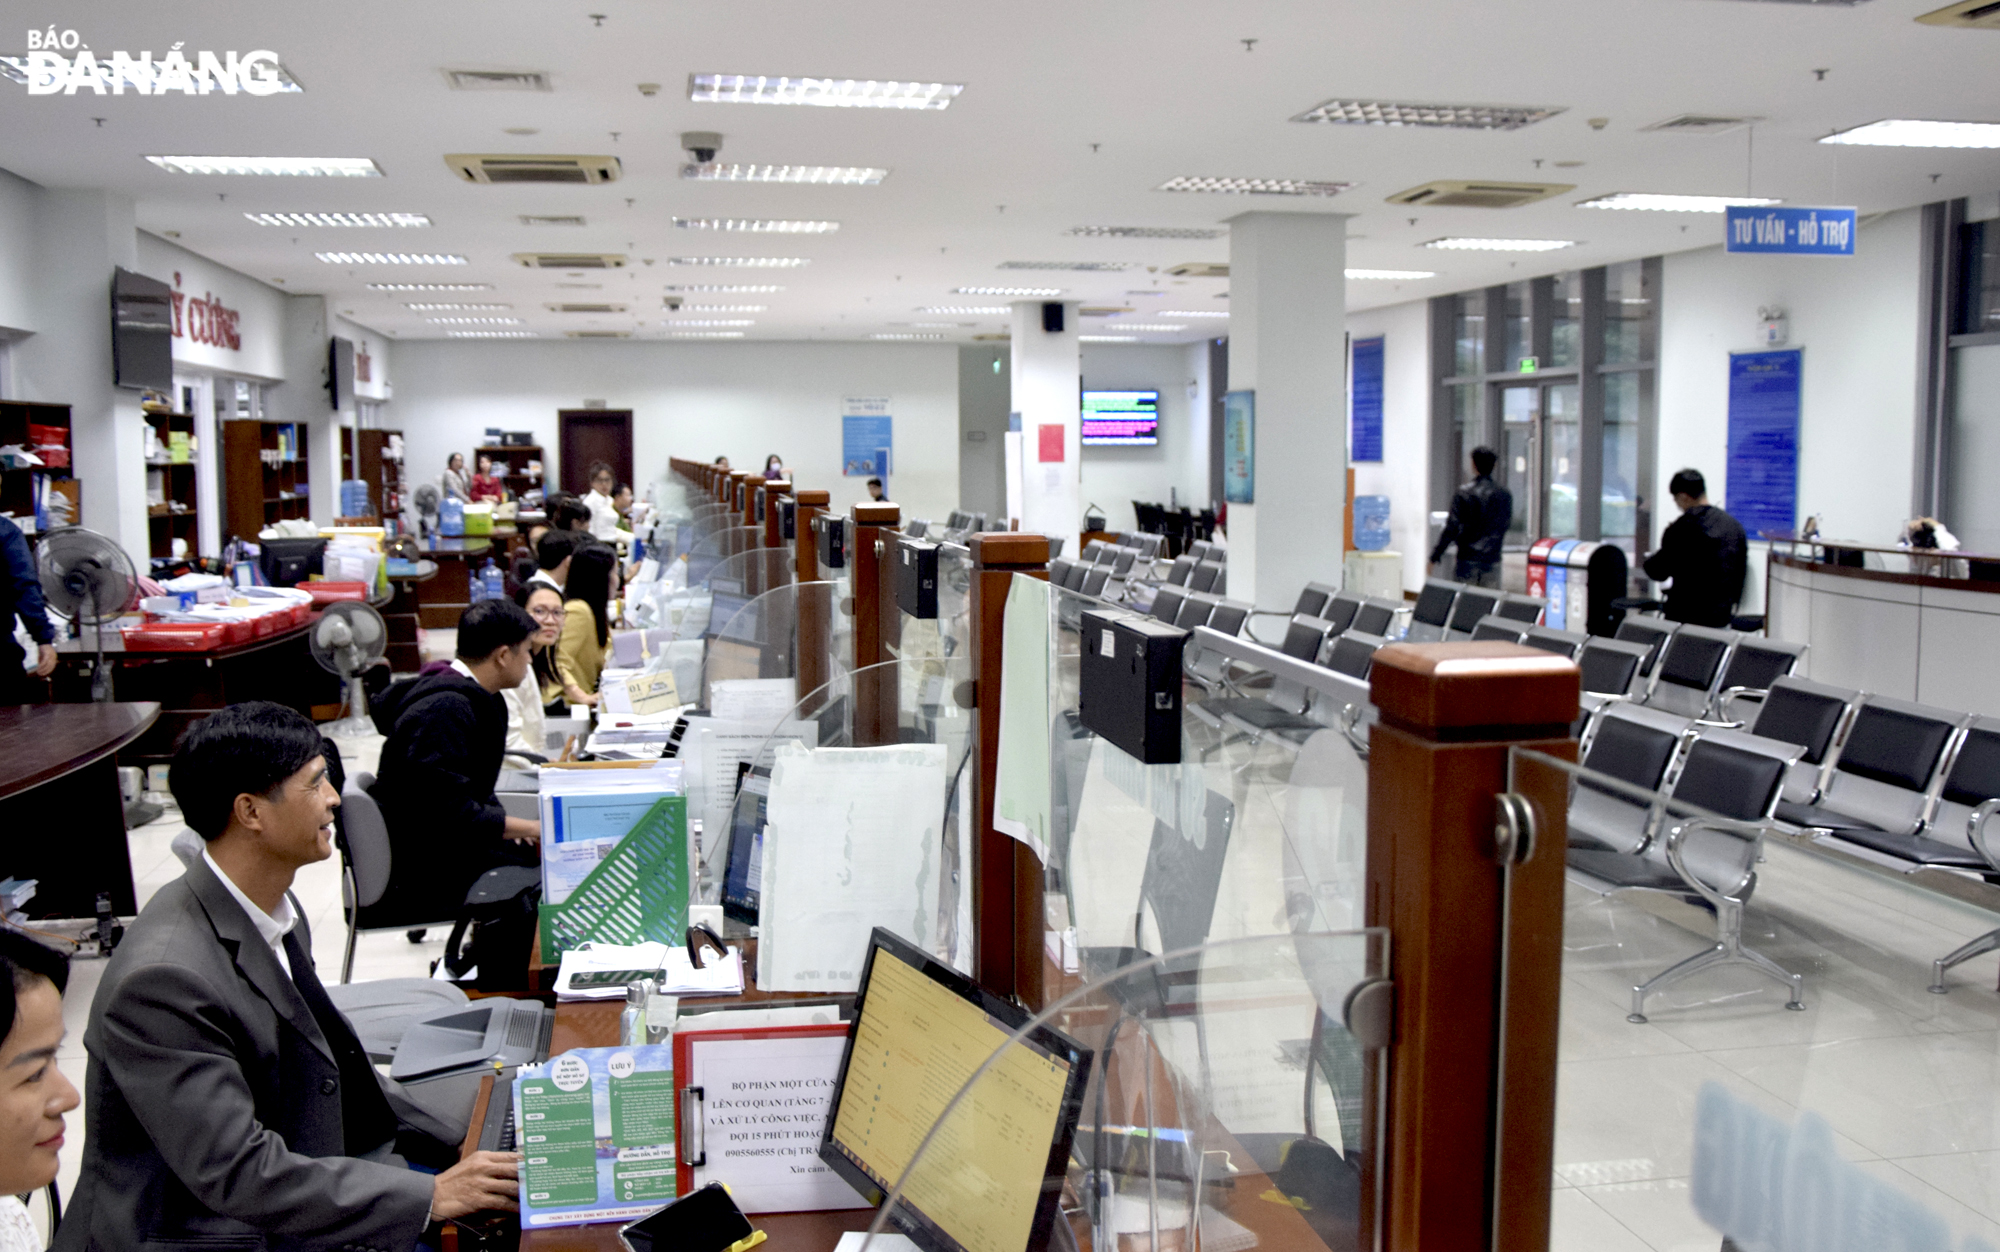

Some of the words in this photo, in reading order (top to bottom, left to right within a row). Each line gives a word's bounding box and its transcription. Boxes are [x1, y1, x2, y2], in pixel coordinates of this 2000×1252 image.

[1733, 216, 1754, 244] TƯ
[1755, 213, 1785, 245] VẤN
[1788, 228, 1796, 236] -
[1798, 211, 1818, 246] HỖ
[1821, 218, 1850, 251] TRỢ
[611, 1062, 625, 1070] LƯU
[627, 1061, 632, 1069] Ý
[732, 1081, 746, 1091] BỘ
[749, 1080, 777, 1091] PHẬN
[779, 1079, 803, 1090] MỘT
[805, 1077, 828, 1088] CỬA
[712, 1099, 732, 1109] LÊN
[735, 1098, 751, 1108] CƠ
[752, 1099, 782, 1109] QUAN
[784, 1097, 816, 1108] (TẦNG
[819, 1097, 824, 1105] 7
[710, 1115, 724, 1125] VÀ
[727, 1115, 743, 1125] XỬ
[745, 1114, 759, 1124] LÝ
[760, 1113, 791, 1124] CÔNG
[793, 1113, 821, 1125] VIỆC,
[730, 1132, 749, 1142] ĐỢI
[752, 1132, 761, 1140] 15
[763, 1130, 791, 1140] PHÚT
[793, 1130, 824, 1140] HOẶC
[725, 1148, 775, 1158] 0905560555
[777, 1148, 797, 1157] (Chị
[790, 1165, 805, 1174] Xin
[807, 1164, 825, 1173] cảm
